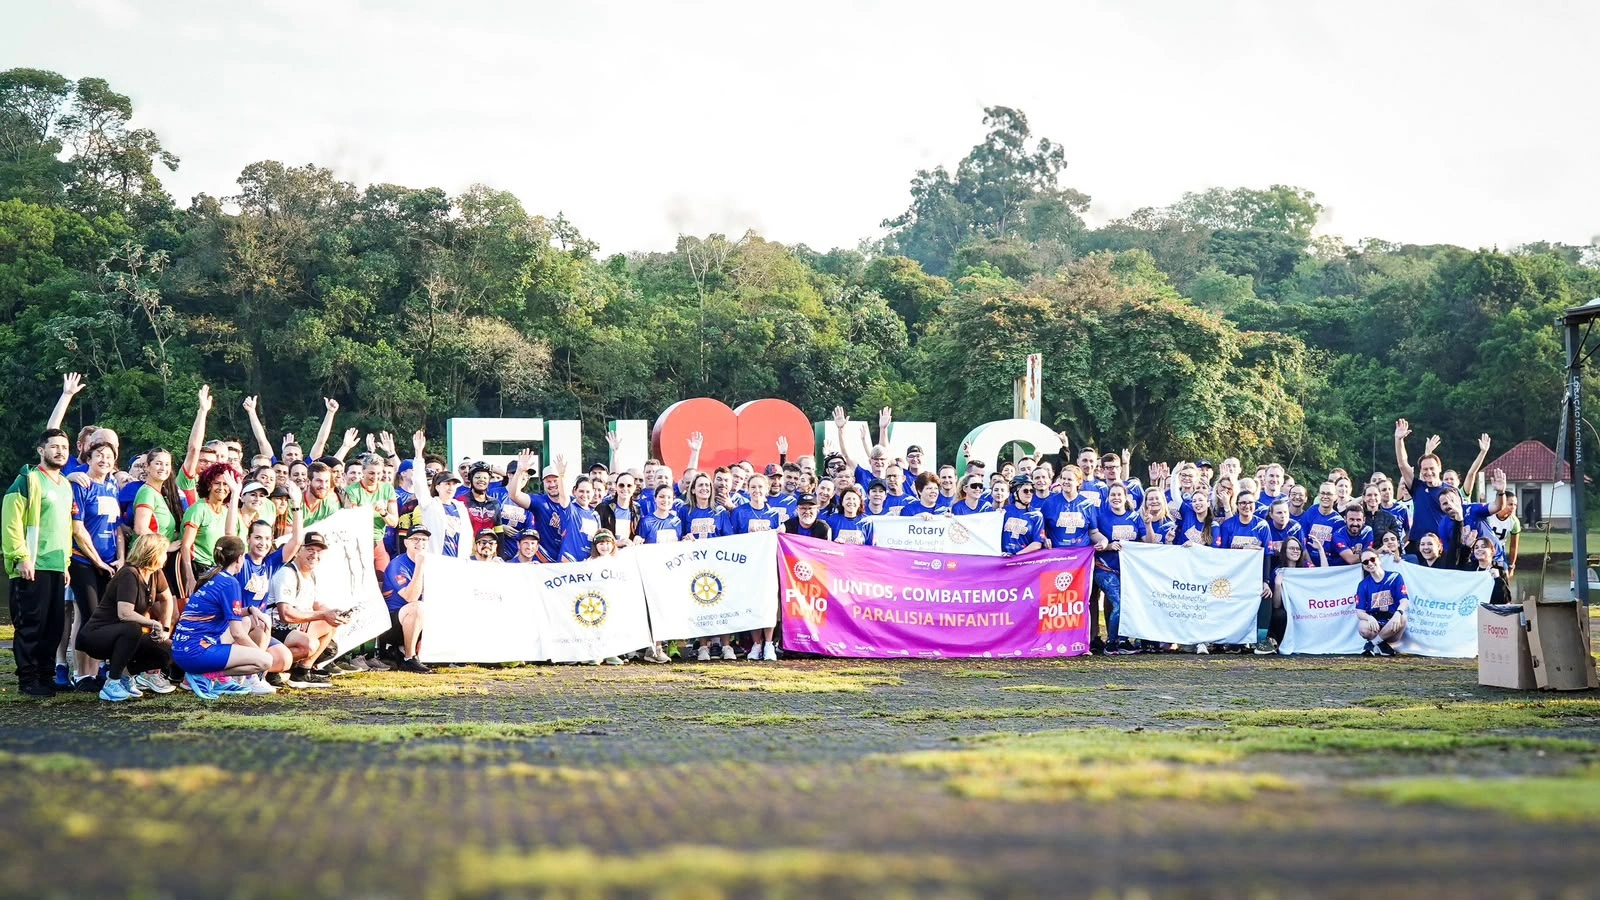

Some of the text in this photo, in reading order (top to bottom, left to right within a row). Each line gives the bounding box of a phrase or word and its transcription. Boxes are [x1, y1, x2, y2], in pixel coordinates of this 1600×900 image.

[1575, 419, 1583, 465] NACIONAL
[908, 524, 945, 537] Rotary
[715, 549, 747, 564] CLUB
[544, 572, 593, 590] ROTARY
[1172, 580, 1208, 594] Rotary
[832, 578, 1034, 604] JUNTOS, COMBATEMOS A
[1047, 589, 1078, 607] END
[1039, 601, 1084, 620] POLIO
[1340, 608, 1358, 616] Rondo
[1413, 595, 1457, 611] Interact
[791, 601, 823, 624] NW
[853, 605, 1015, 628] PARALISIA INFANTIL
[1042, 614, 1080, 631] NOW
